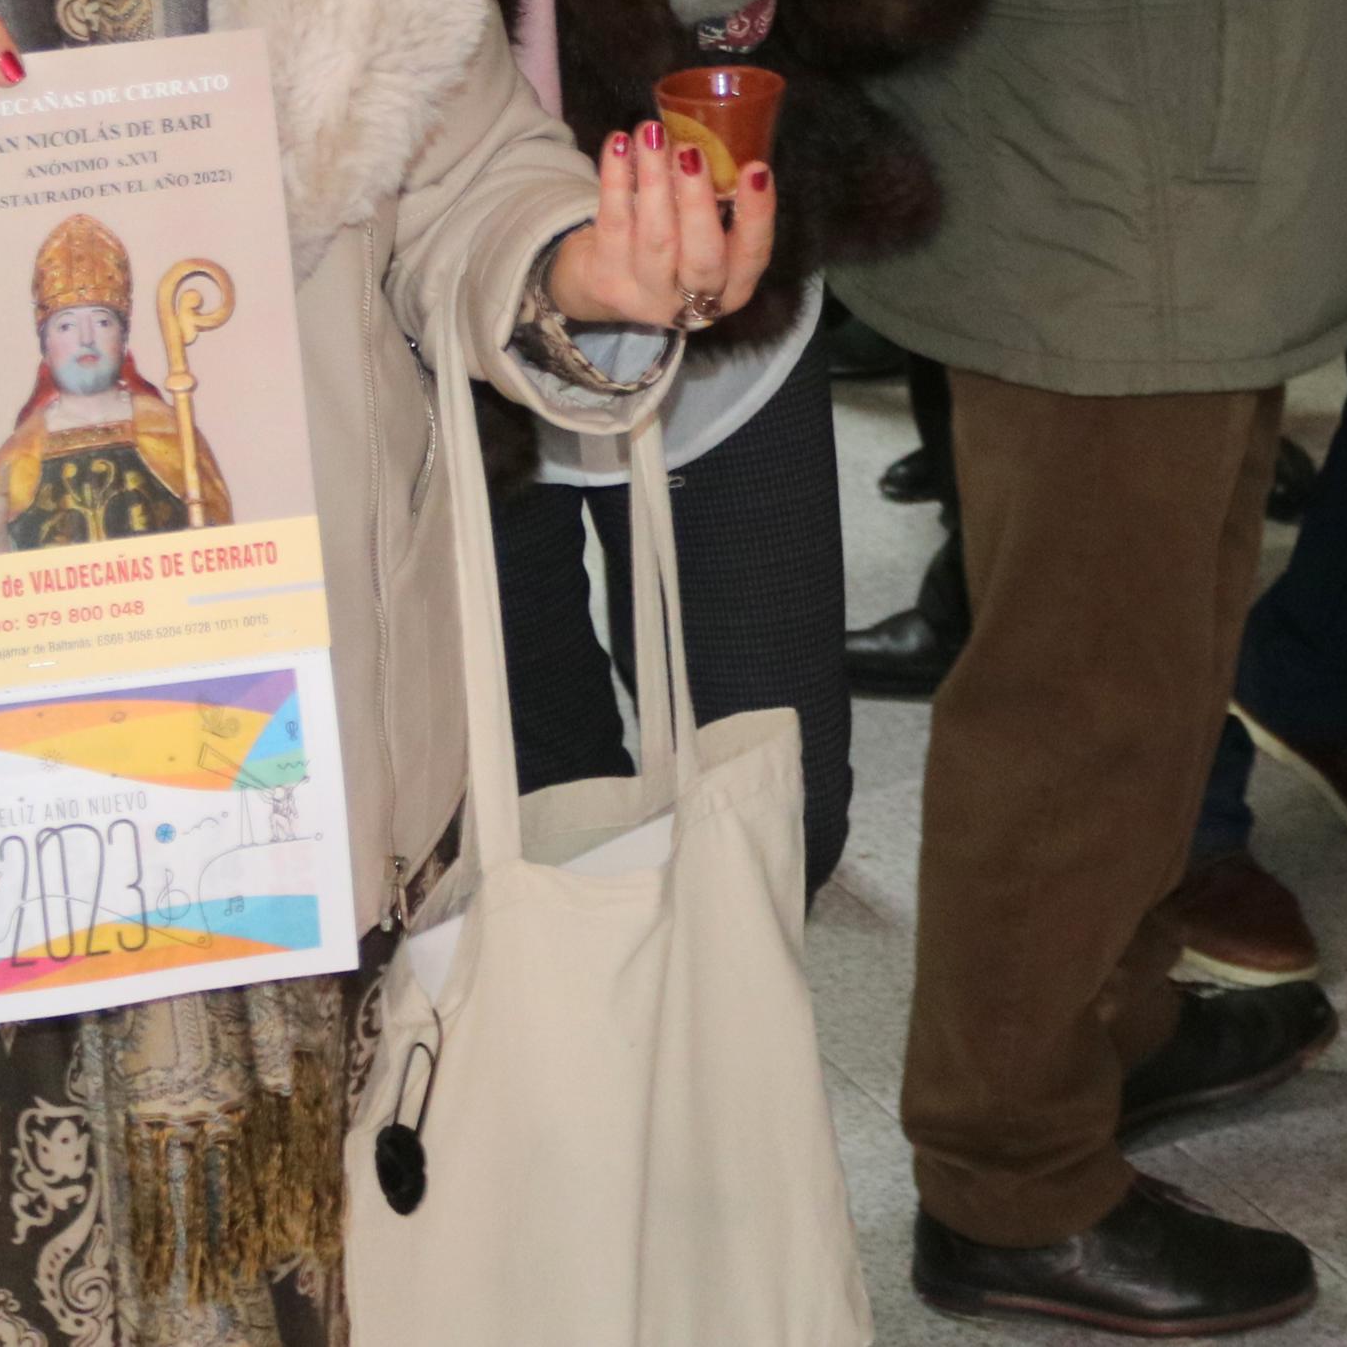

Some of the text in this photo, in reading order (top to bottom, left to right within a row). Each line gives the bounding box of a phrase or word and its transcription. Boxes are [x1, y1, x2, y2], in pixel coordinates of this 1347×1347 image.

[92, 86, 119, 105] DE
[125, 74, 230, 101] CERRATO
[27, 122, 121, 150] NICOLÁS
[127, 121, 154, 139] DE
[161, 113, 213, 134] BARI
[26, 151, 158, 179] ANÓNIMO s.XVI
[100, 183, 122, 197] EN
[127, 180, 148, 193] EL
[154, 173, 190, 189] AÑO
[195, 168, 233, 185] 2022)
[2, 575, 24, 598] de
[29, 554, 154, 595] VALDECAÑAS
[161, 553, 185, 578] DE
[191, 541, 279, 574] CERRATO
[27, 611, 62, 629] 979
[68, 605, 103, 624] 800
[110, 600, 144, 619] 048
[33, 643, 46, 654] de
[185, 622, 211, 635] 9728
[215, 618, 239, 631] 1011
[45, 797, 80, 820] AÑO
[88, 790, 147, 816] NUEVO
